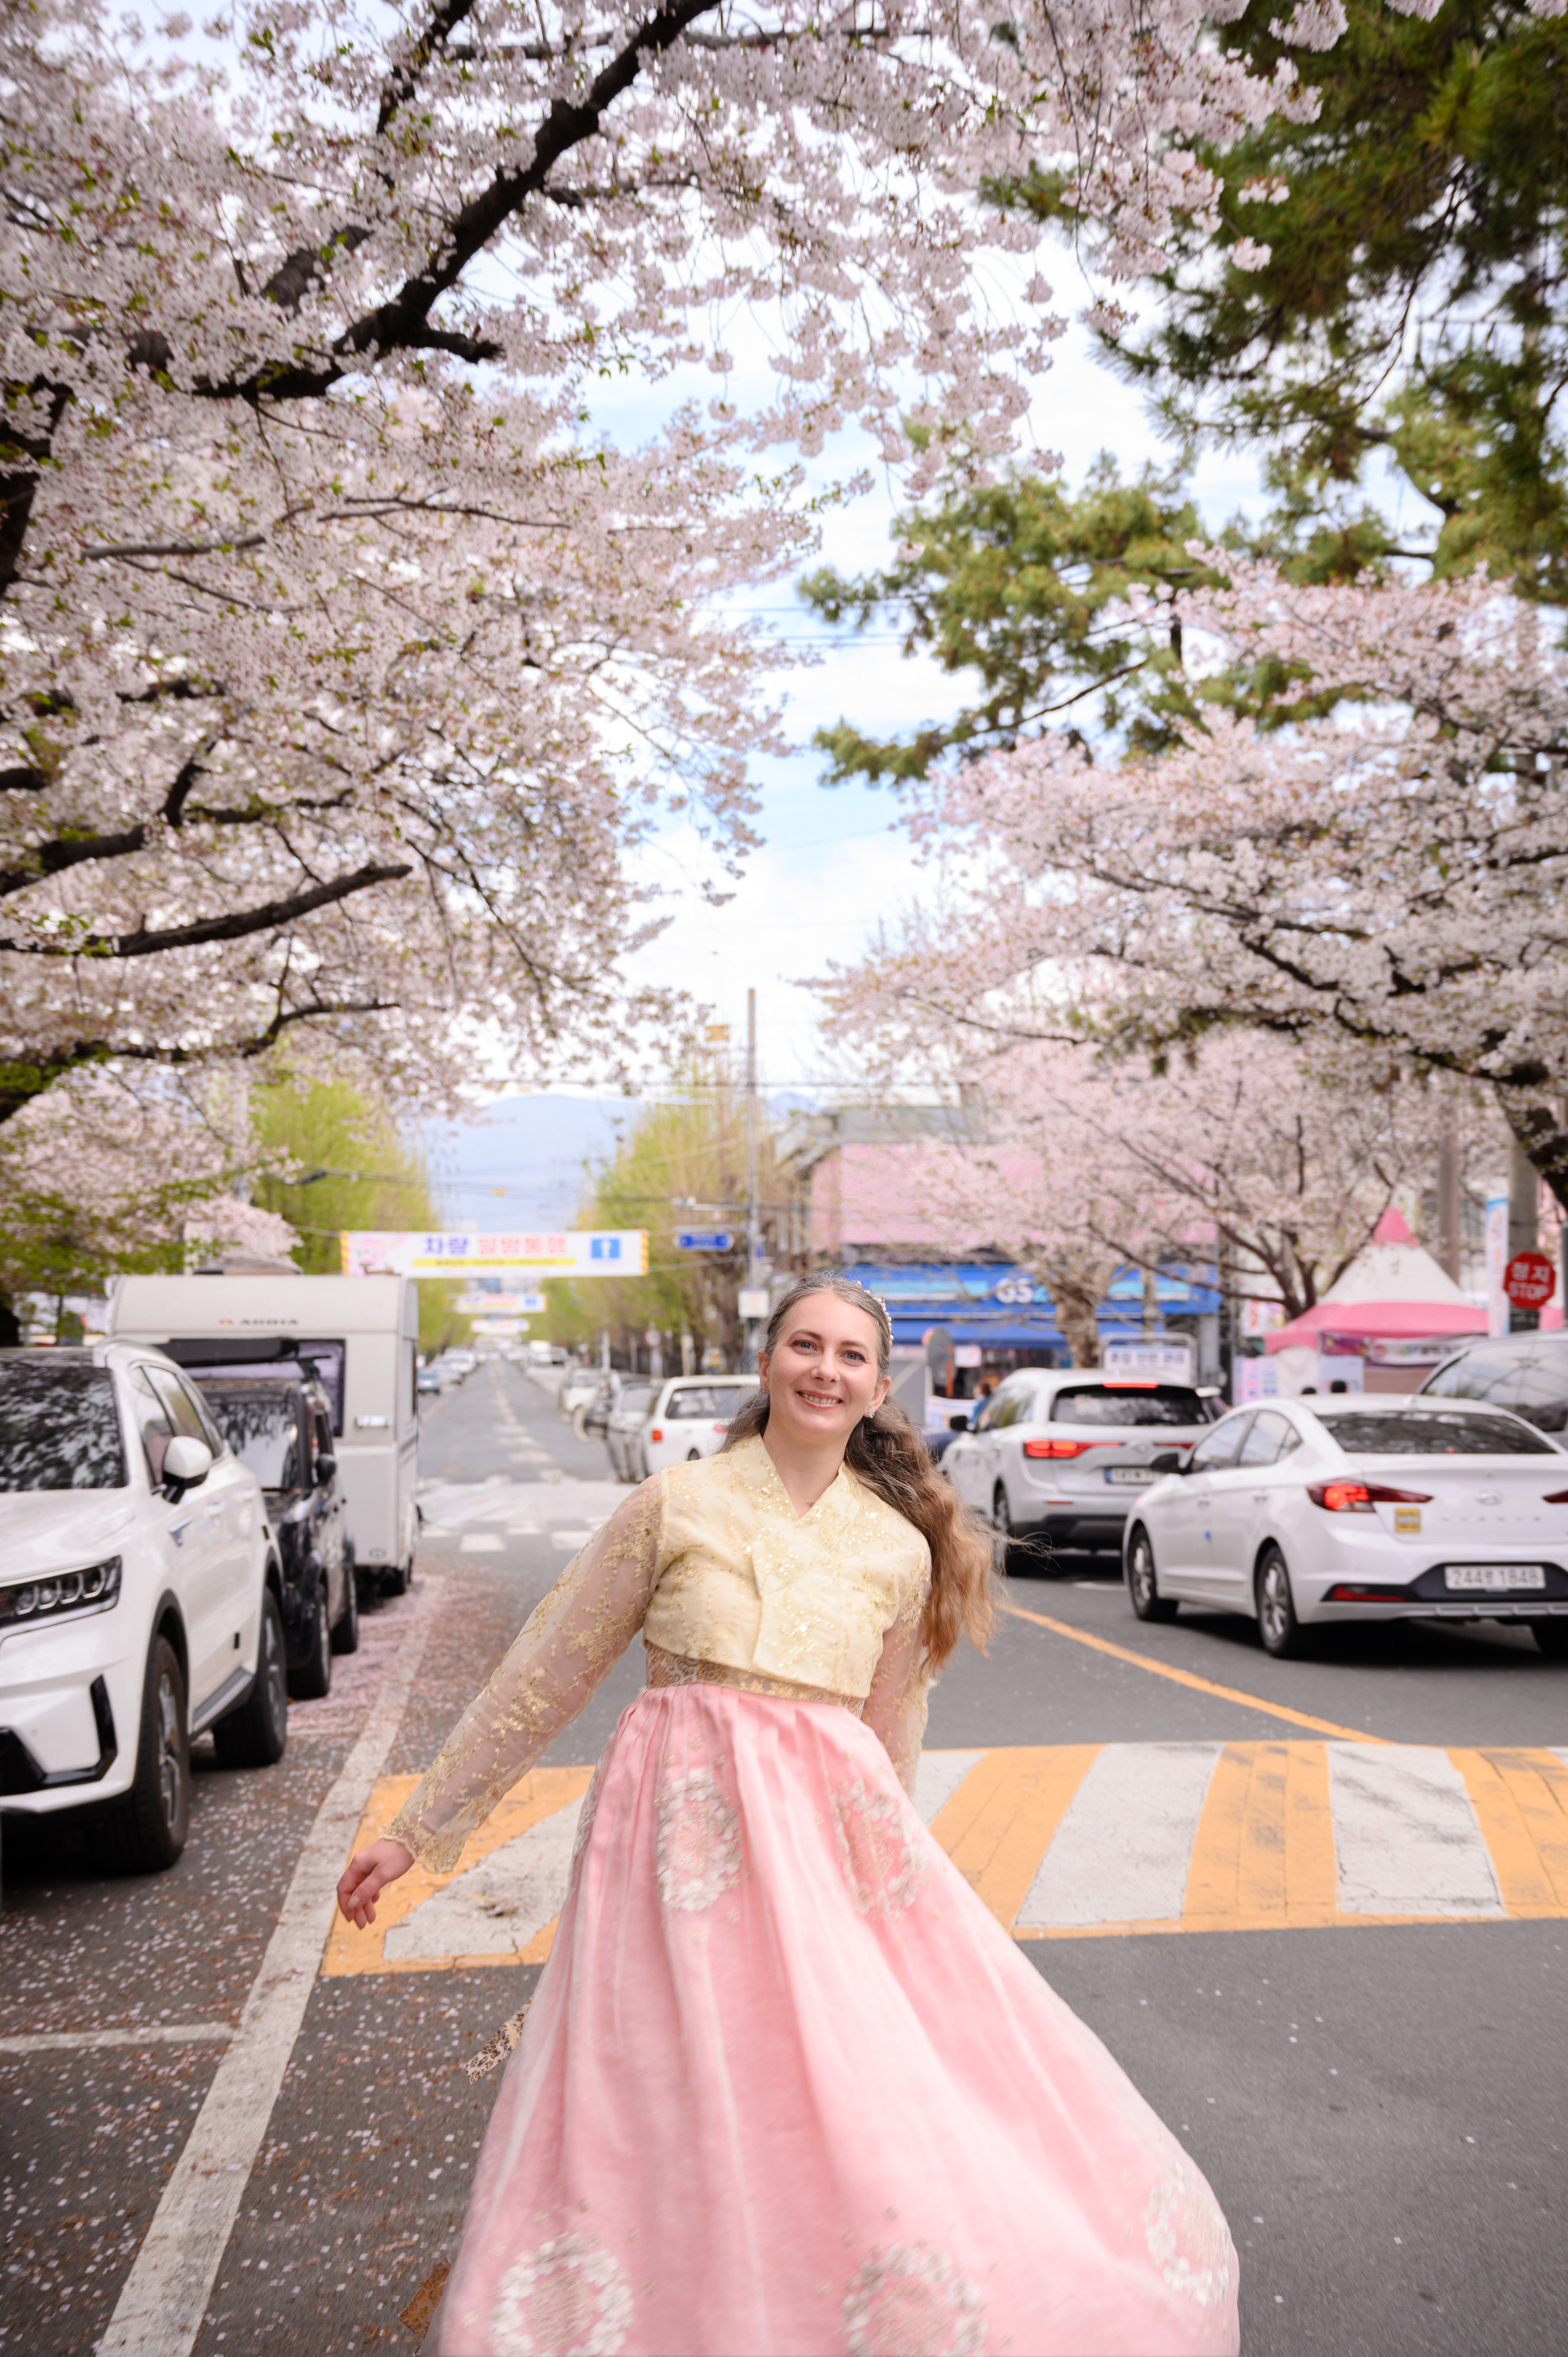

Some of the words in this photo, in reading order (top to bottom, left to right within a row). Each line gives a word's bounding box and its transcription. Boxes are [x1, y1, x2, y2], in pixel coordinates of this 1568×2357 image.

[426, 1238, 469, 1254] 차량
[478, 1237, 567, 1254] 일방통행
[1510, 1261, 1550, 1283] 정지
[1509, 1281, 1549, 1299] STOP
